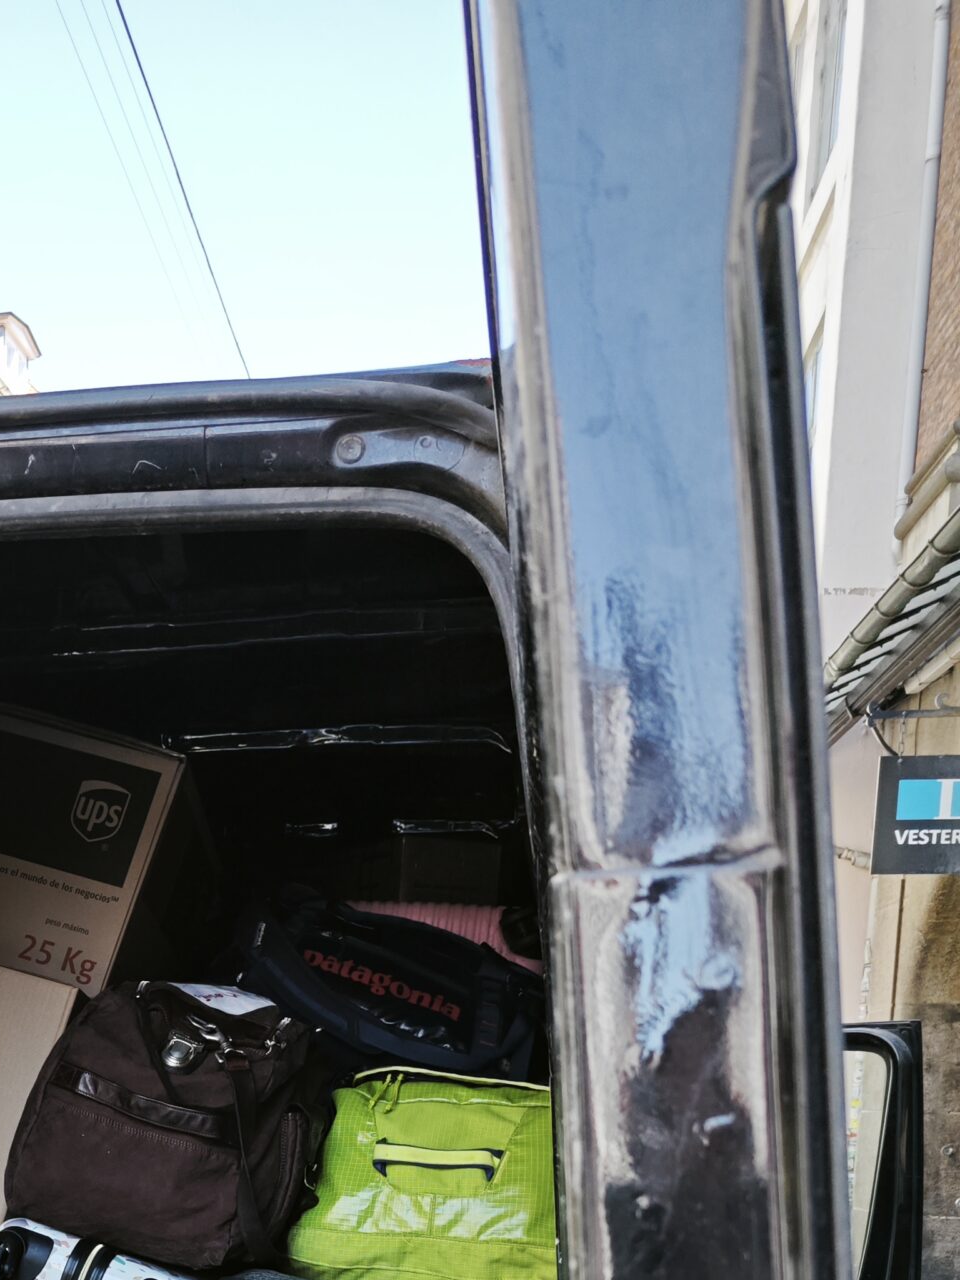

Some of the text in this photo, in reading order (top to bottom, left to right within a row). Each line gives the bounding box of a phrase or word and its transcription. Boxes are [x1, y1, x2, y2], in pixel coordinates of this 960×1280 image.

[10, 869, 19, 877] el
[20, 871, 48, 886] mundo
[49, 879, 60, 889] de
[62, 881, 74, 894] los
[45, 917, 61, 929] peso
[17, 933, 98, 985] 25 Kg
[304, 949, 461, 1022] patagonia
